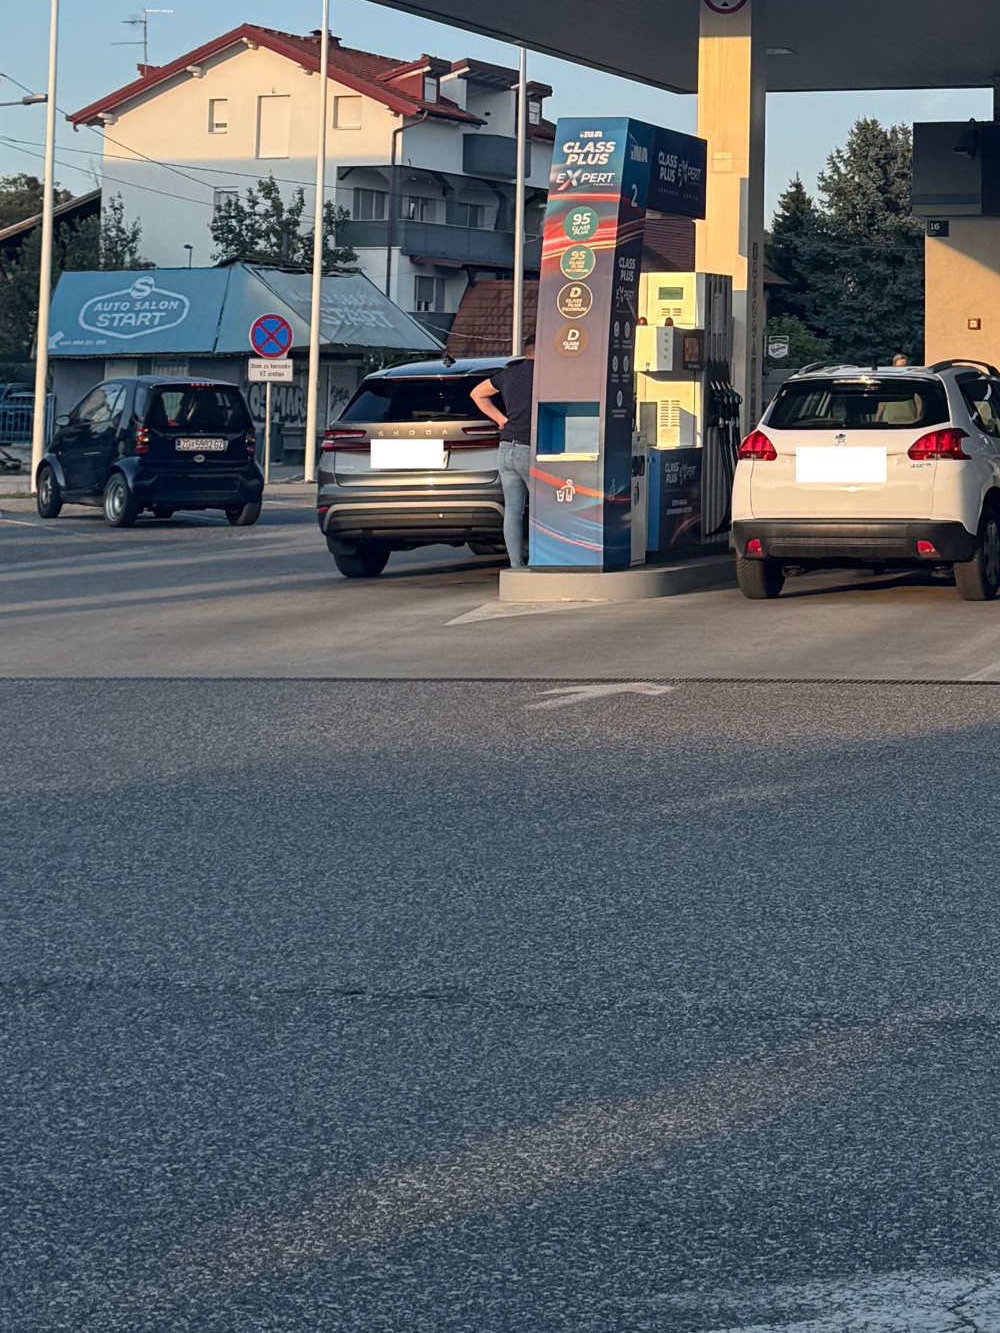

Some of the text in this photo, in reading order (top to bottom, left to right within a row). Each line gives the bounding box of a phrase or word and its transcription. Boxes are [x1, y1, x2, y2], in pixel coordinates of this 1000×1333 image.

[562, 141, 616, 154] CLASS
[565, 153, 610, 166] PLUS
[658, 151, 678, 169] CLASS
[659, 166, 676, 183] PLUS
[631, 183, 638, 207] 2
[572, 213, 592, 225] 95
[570, 250, 586, 260] 95
[618, 257, 636, 269] CLASS
[620, 269, 635, 282] PLUS
[569, 287, 582, 298] D
[93, 300, 180, 312] AUTO SALON
[96, 312, 166, 327] START
[567, 329, 580, 341] D
